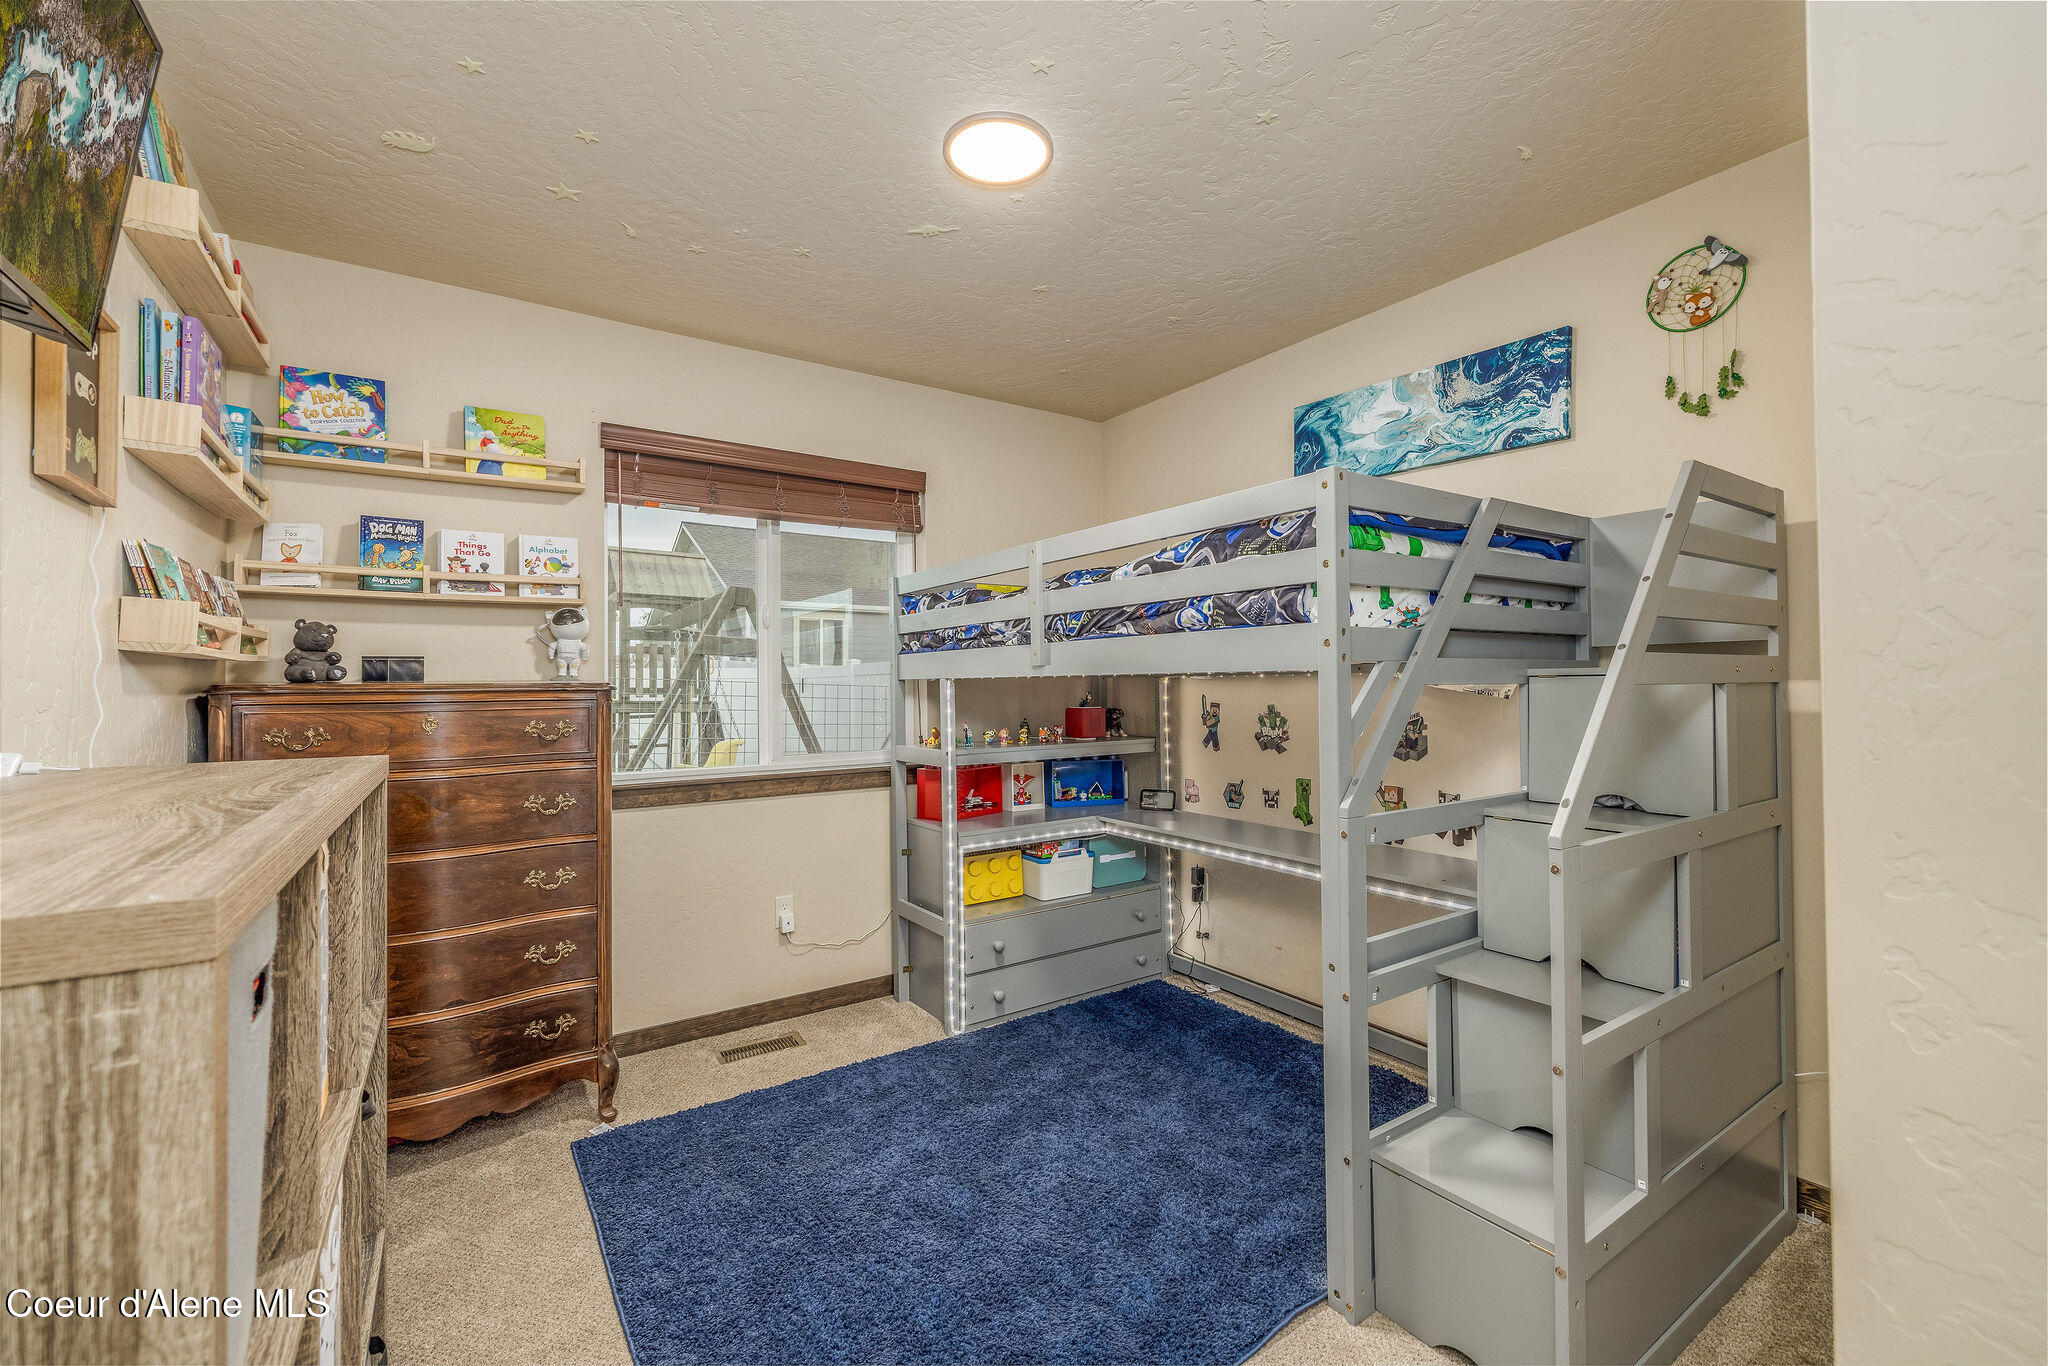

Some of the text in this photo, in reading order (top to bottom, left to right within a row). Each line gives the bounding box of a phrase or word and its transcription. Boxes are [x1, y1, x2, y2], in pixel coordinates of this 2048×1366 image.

[163, 359, 173, 390] 5-Minute
[309, 390, 345, 405] How
[302, 401, 365, 419] to Catch
[494, 416, 514, 424] Dad
[501, 430, 539, 441] Anything
[368, 522, 418, 536] DOG MAN
[458, 541, 487, 550] Things
[528, 546, 568, 554] Alphabet
[454, 548, 475, 556] That
